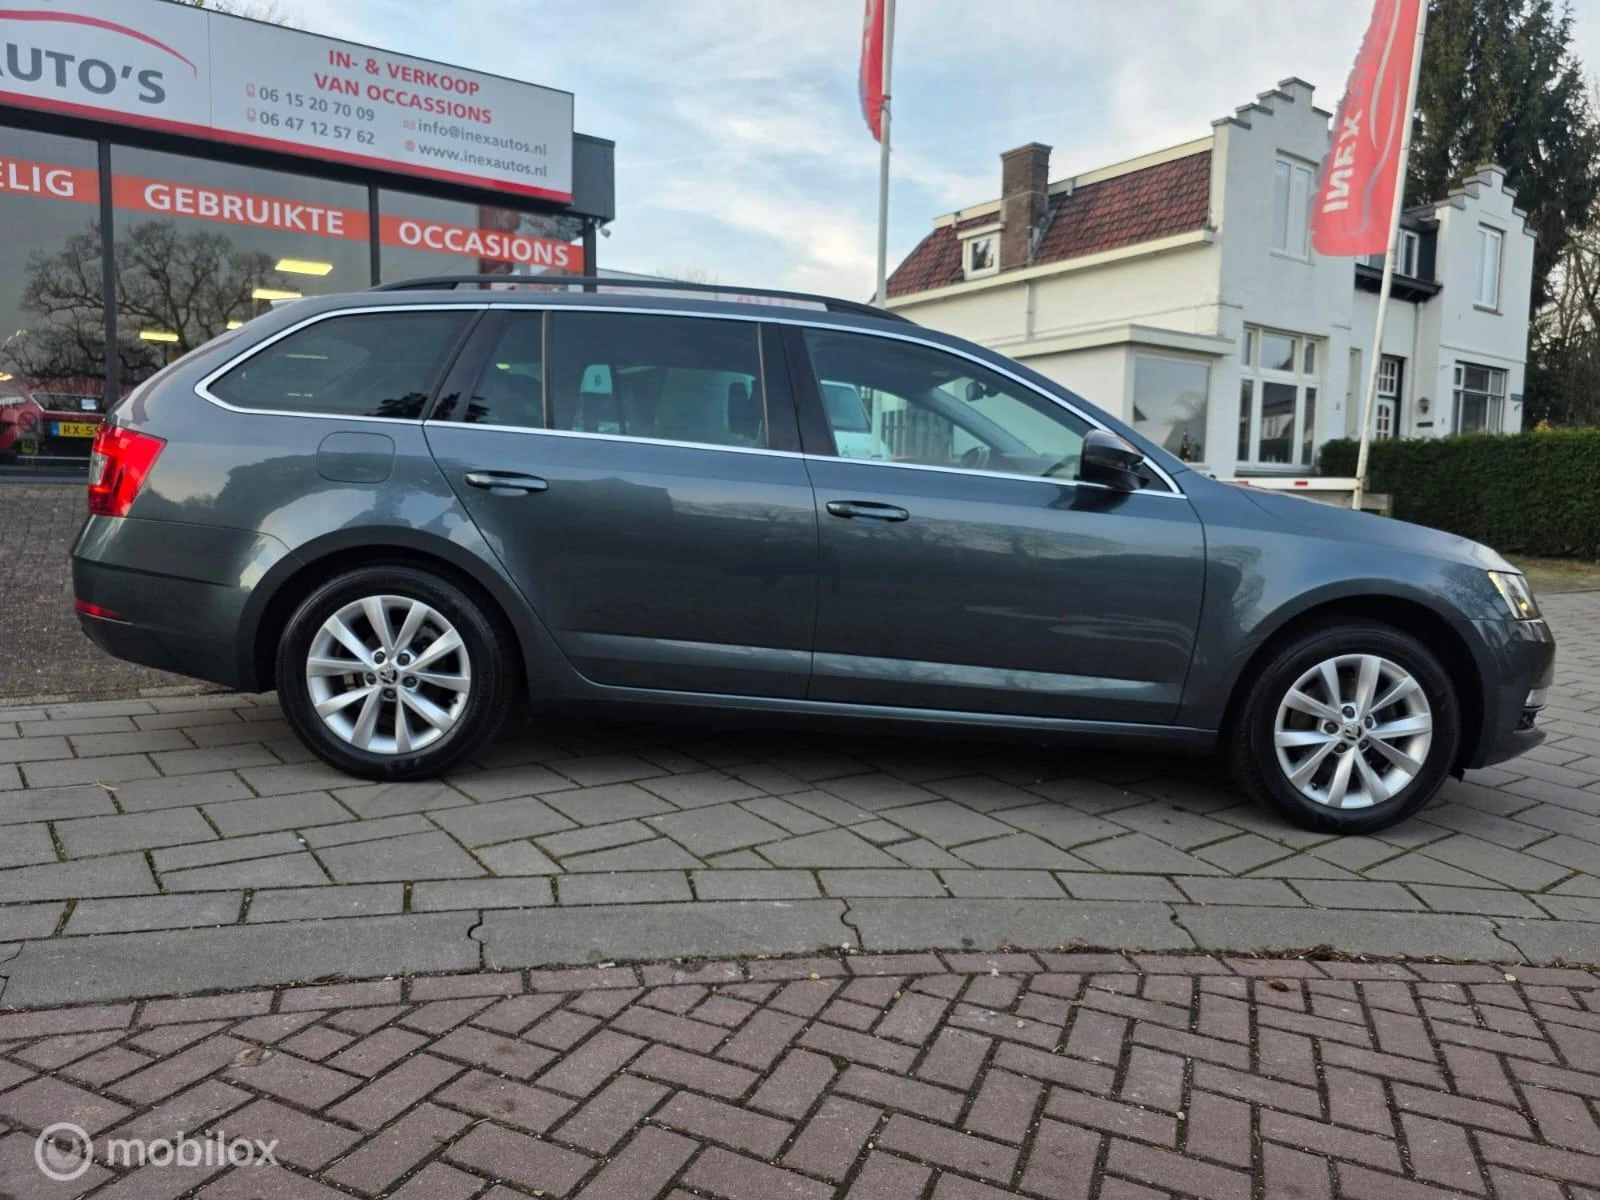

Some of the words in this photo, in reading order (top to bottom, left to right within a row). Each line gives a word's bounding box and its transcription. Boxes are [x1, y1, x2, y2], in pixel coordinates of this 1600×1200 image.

[0, 42, 166, 104] UTO'S
[329, 49, 358, 69] IN-
[365, 58, 380, 75] &
[386, 62, 480, 96] VERKOOP
[259, 87, 279, 102] 06
[285, 92, 304, 107] 15
[309, 97, 328, 112] 20
[333, 102, 351, 117] 70
[356, 107, 374, 121] 09
[314, 73, 360, 97] VAN
[367, 85, 492, 125] OCCASSIONS
[260, 112, 280, 127] 06
[285, 117, 304, 131] 47
[310, 121, 328, 136] 12
[334, 126, 351, 140] 57
[357, 130, 375, 145] 62
[418, 118, 547, 156] info@inexautos.nl
[418, 143, 548, 177] www.inexautos.nl
[0, 161, 74, 197] LIG
[144, 184, 344, 235] GEBRUIKTE
[398, 221, 569, 266] OCCASIONS
